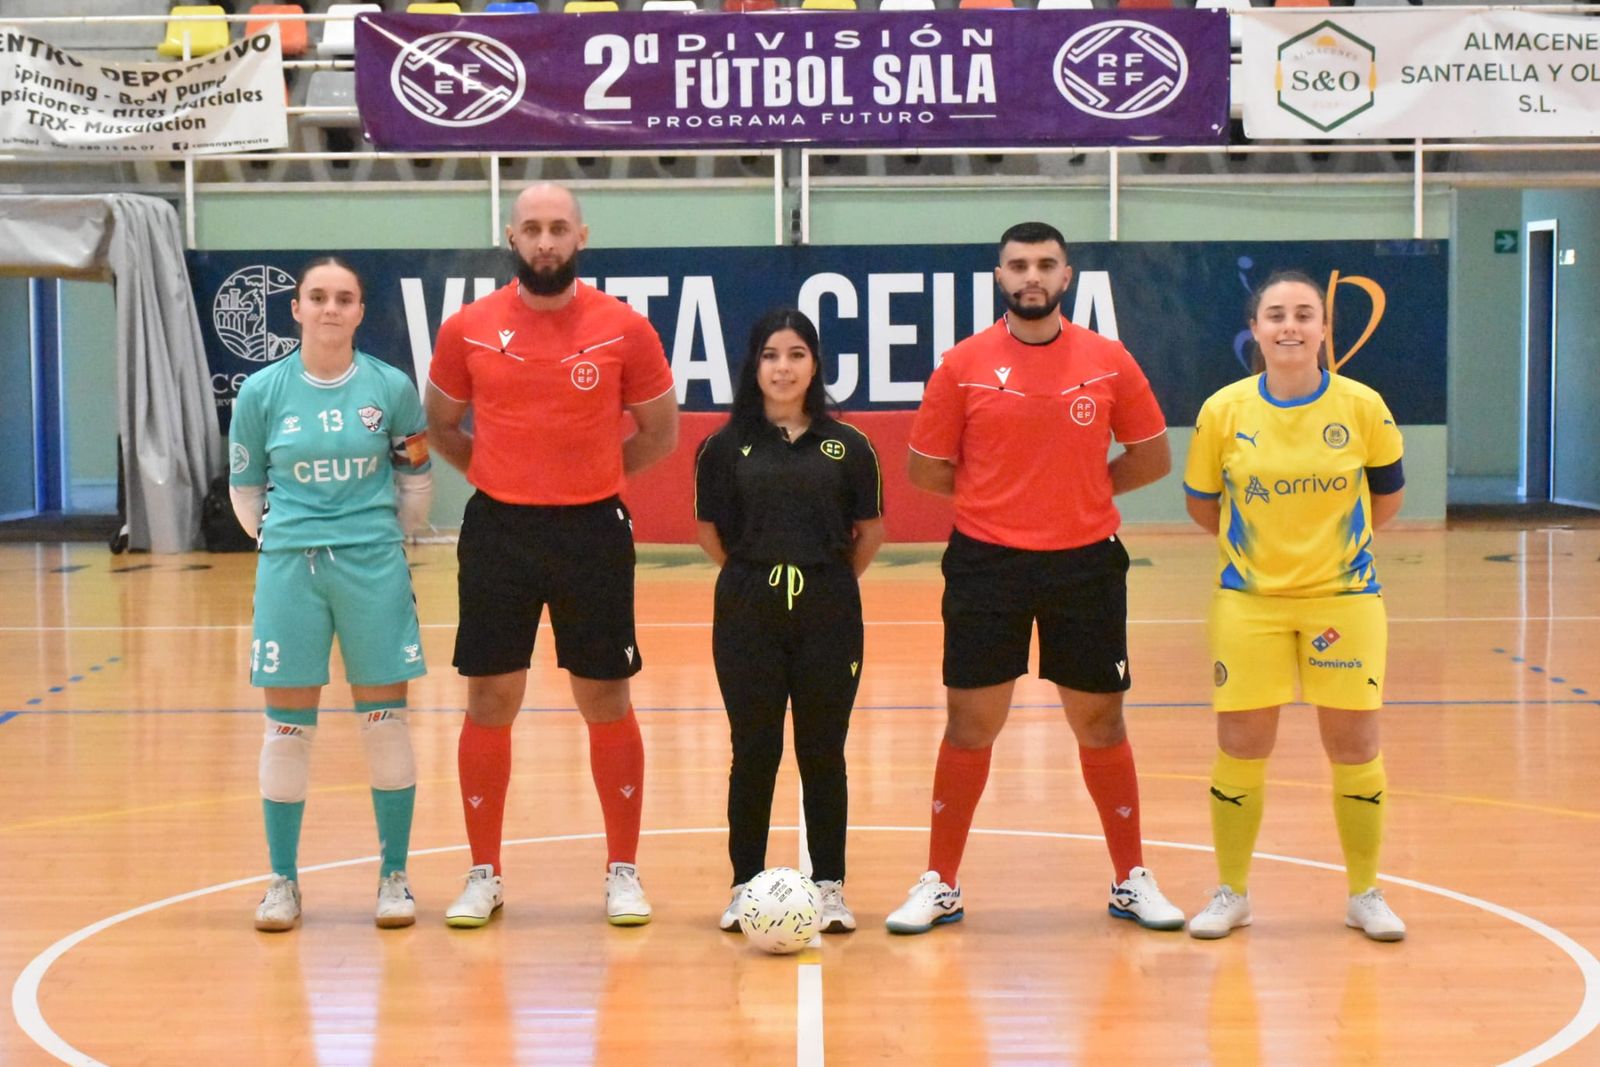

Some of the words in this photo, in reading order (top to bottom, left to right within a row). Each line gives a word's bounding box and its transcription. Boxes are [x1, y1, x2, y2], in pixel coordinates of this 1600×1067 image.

[678, 23, 993, 51] DIVISIÓN
[1464, 32, 1599, 51] ALMACENE
[584, 33, 658, 110] 2ª
[675, 51, 853, 109] FÚTBOL
[873, 53, 997, 106] SALA
[1291, 70, 1360, 92] S&O
[1401, 63, 1540, 84] SANTAELLA
[1548, 64, 1563, 82] Y
[1571, 63, 1600, 82] OL
[1519, 95, 1557, 113] S.L.
[648, 113, 805, 127] PROGRAMA
[821, 111, 934, 125] FUTURO
[317, 409, 344, 433] 13
[251, 639, 280, 673] 13
[1308, 656, 1362, 669] Domino's
